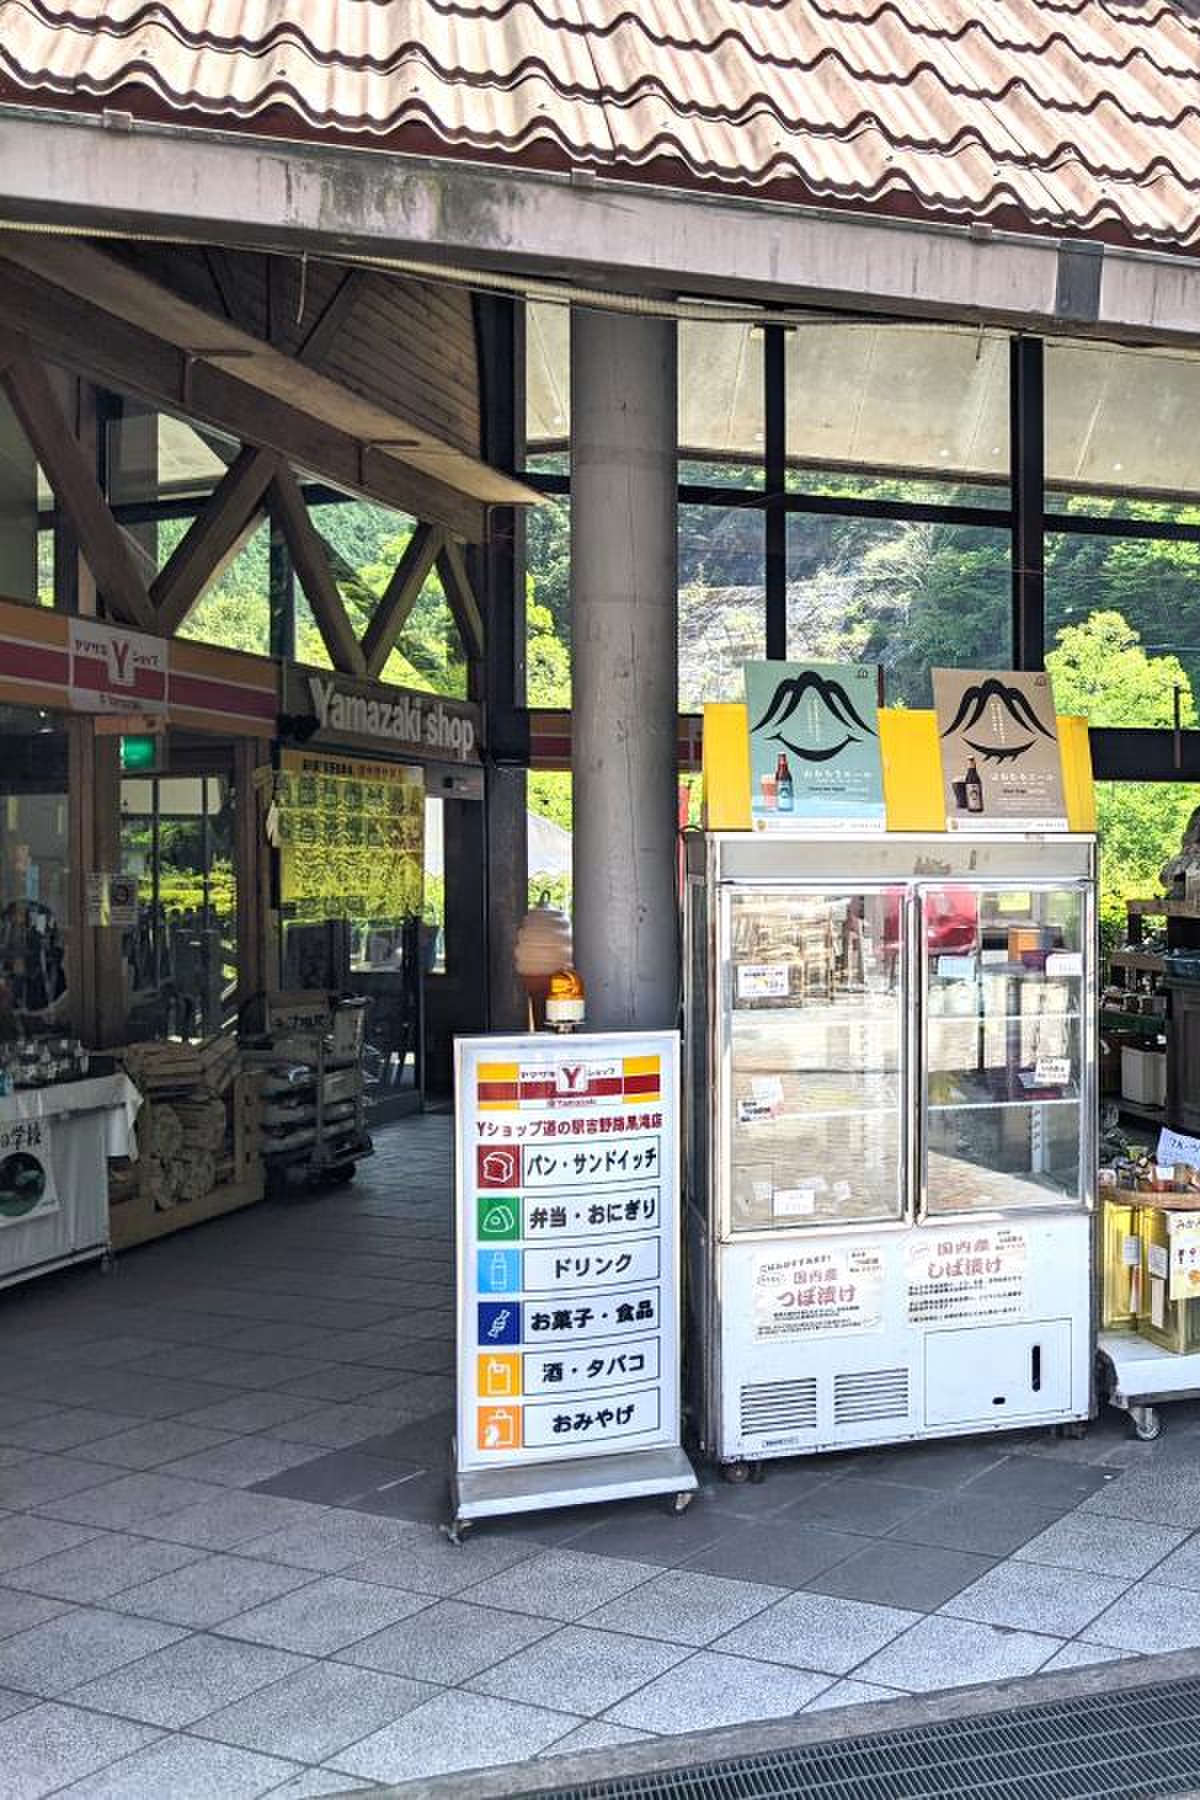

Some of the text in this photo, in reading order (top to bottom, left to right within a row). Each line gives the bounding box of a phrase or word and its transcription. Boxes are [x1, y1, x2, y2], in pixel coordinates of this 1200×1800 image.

[308, 677, 475, 761] Yamazaki shop
[561, 1067, 581, 1089] Y
[476, 1112, 663, 1137] Yショップ道の駅吉野路黒滝店
[527, 1147, 657, 1176] パン・サンドイッチ
[529, 1198, 656, 1230] 弁当・おにぎり
[555, 1253, 633, 1279] ドリンク
[927, 1257, 1004, 1279] しば漬け
[530, 1299, 654, 1332] お菓子・食品
[541, 1354, 646, 1383] 酒・タバコ
[552, 1404, 635, 1434] おみやげ
